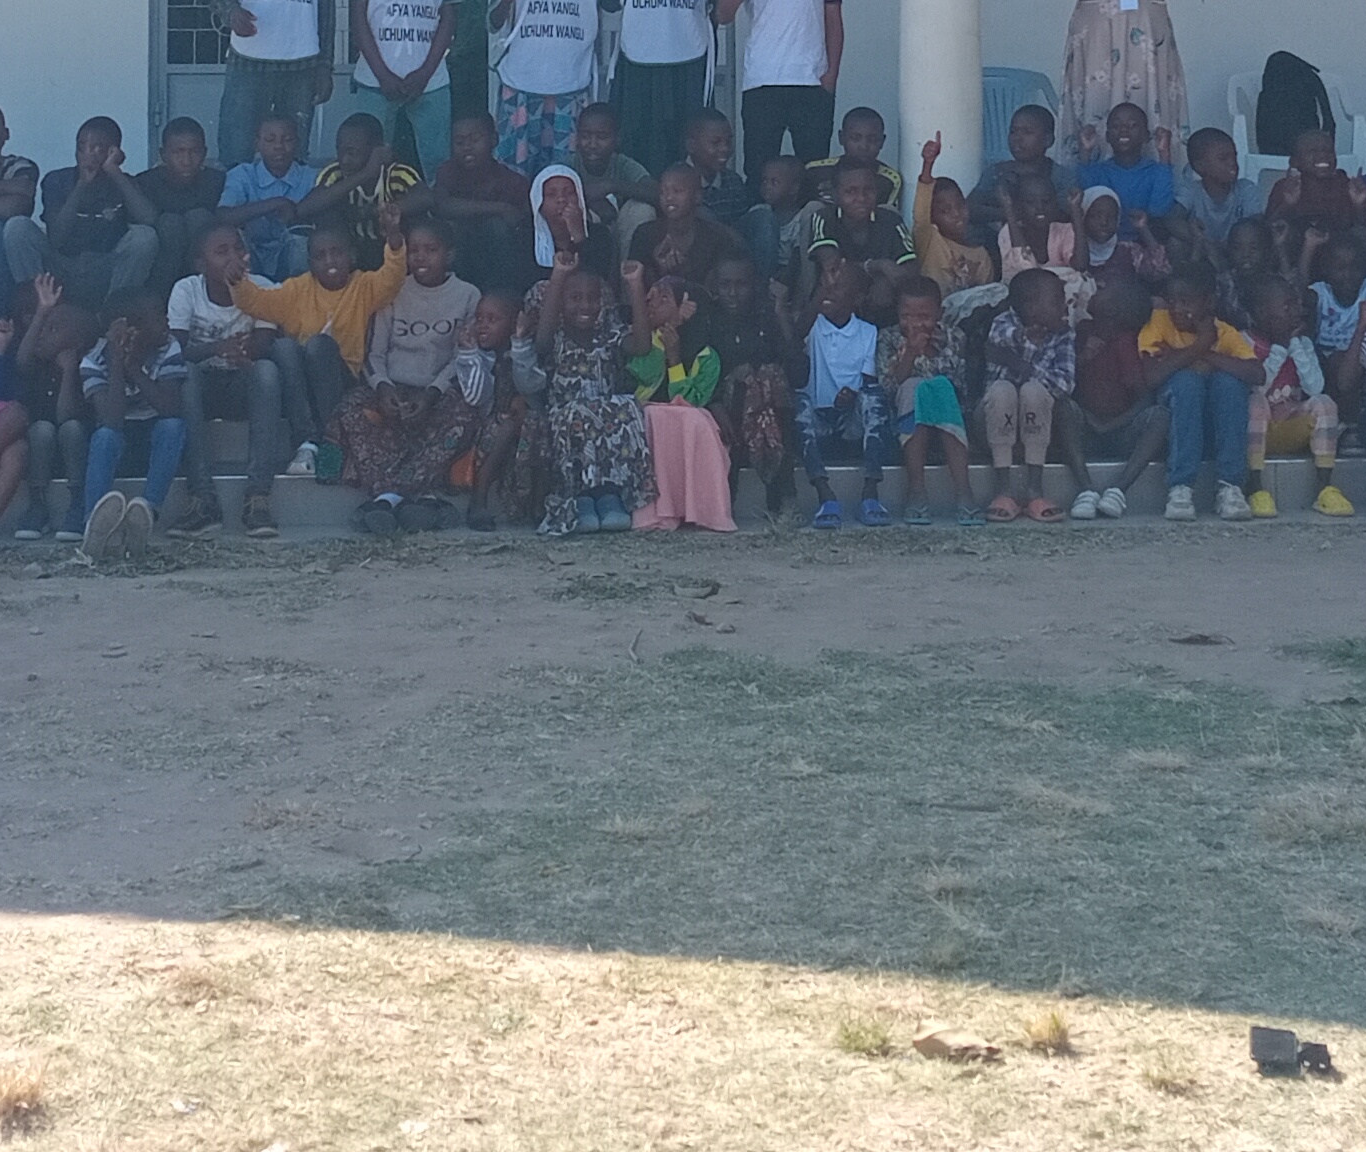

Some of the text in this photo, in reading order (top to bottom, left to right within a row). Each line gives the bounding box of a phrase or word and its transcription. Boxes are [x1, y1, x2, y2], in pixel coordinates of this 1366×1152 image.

[386, 3, 409, 17] AFYA
[527, 0, 581, 17] AFYA YANGU
[378, 27, 415, 42] UCHUMI
[520, 24, 585, 41] UCHUMI WANGU
